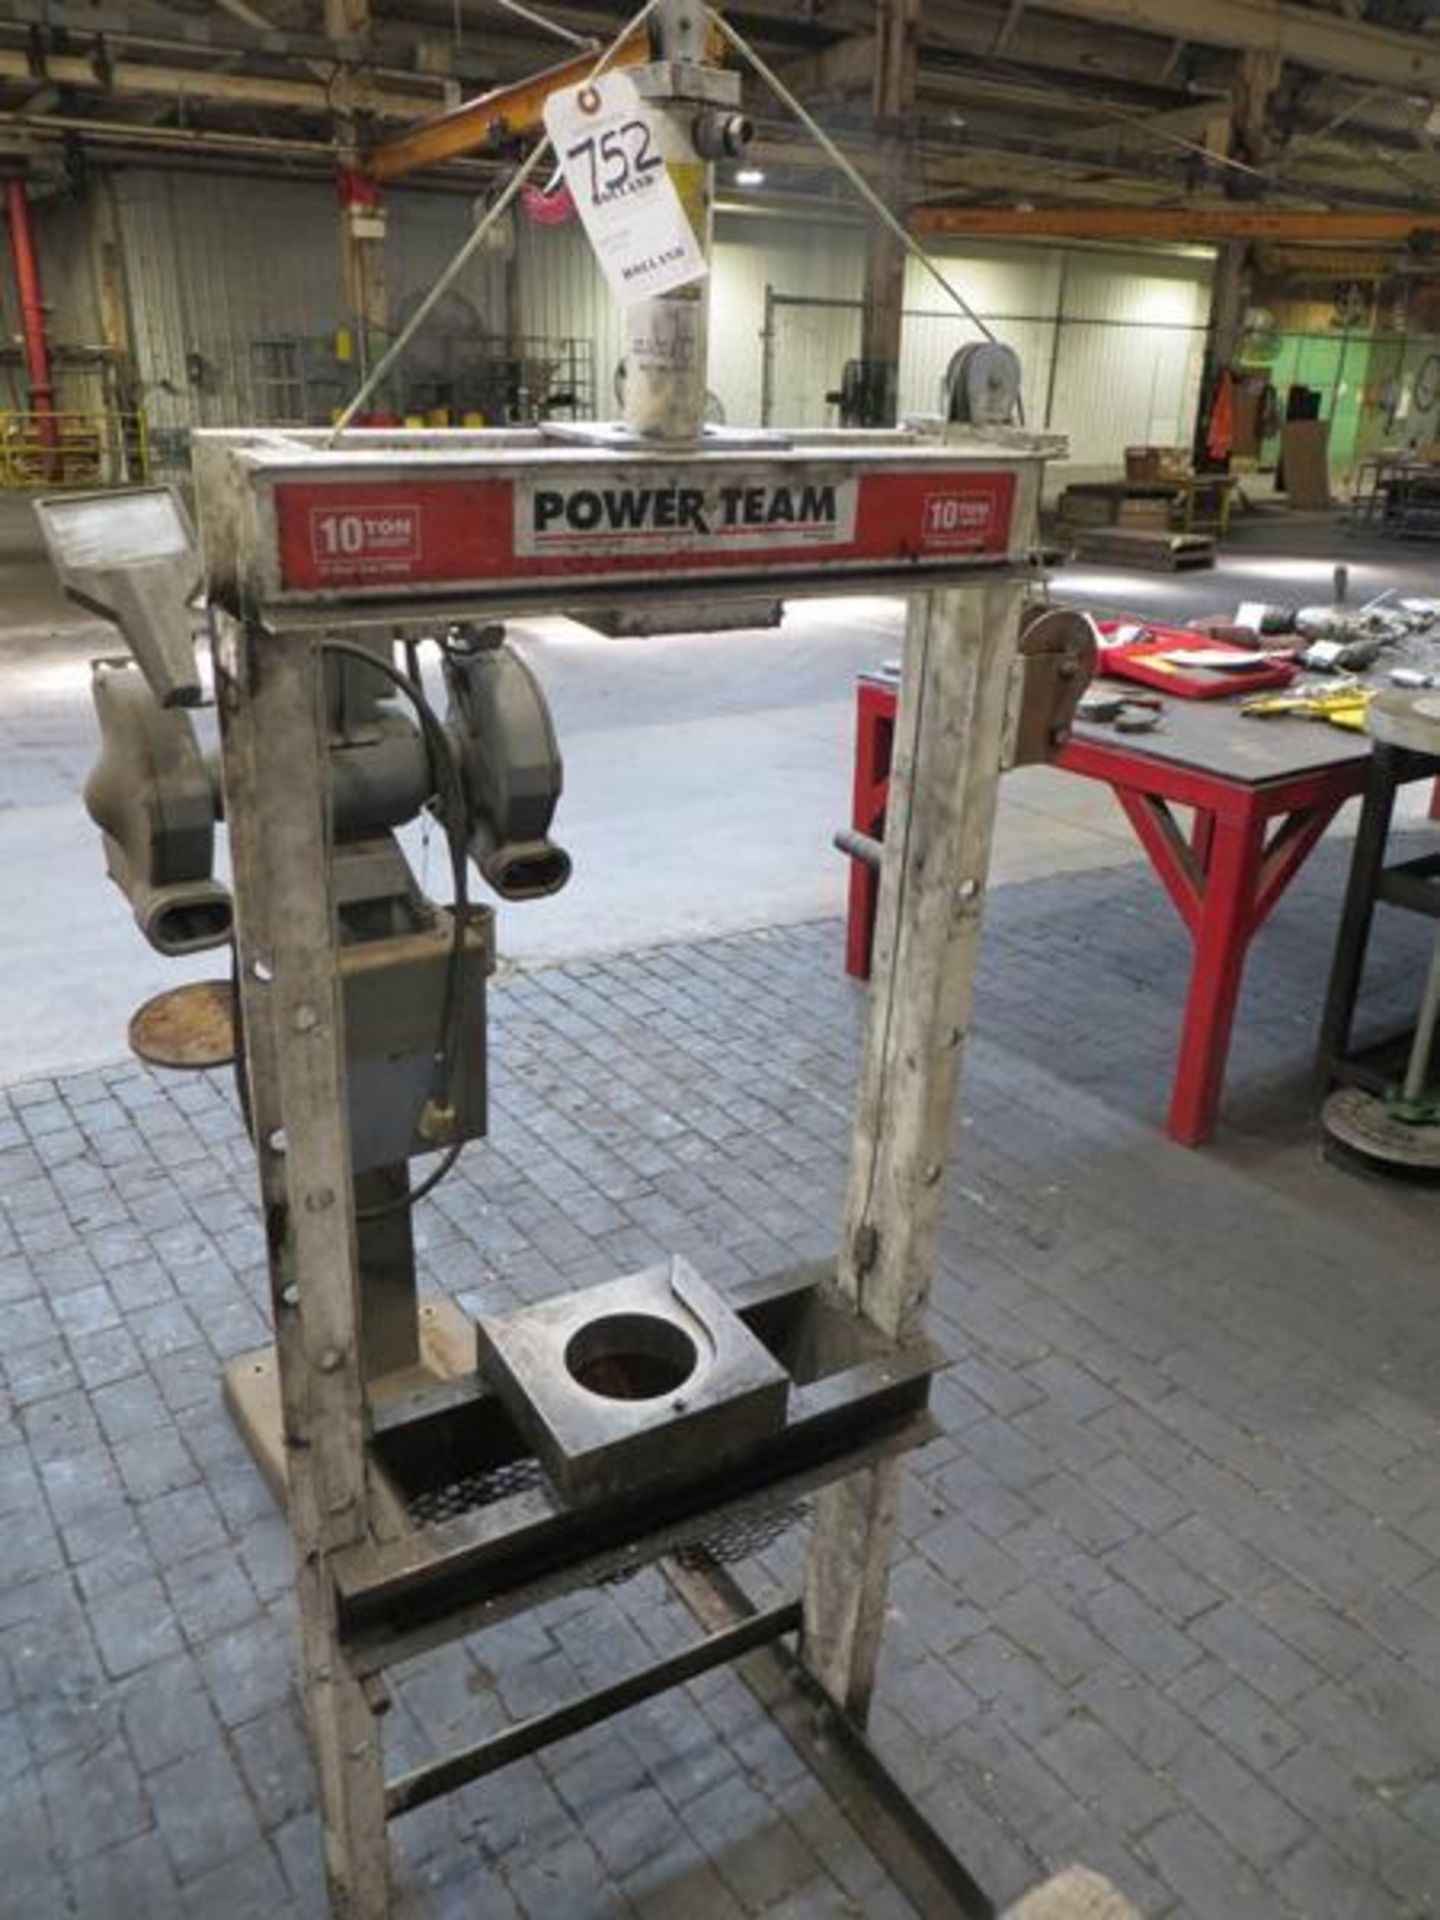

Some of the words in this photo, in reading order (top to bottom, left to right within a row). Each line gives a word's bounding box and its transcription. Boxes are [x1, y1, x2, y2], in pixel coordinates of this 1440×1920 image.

[567, 120, 662, 205] 752
[593, 175, 655, 203] OLLAND
[534, 488, 711, 535] POWER
[720, 485, 836, 526] TEAM
[931, 500, 957, 530] 10
[319, 515, 363, 554] 10
[364, 517, 411, 536] TON
